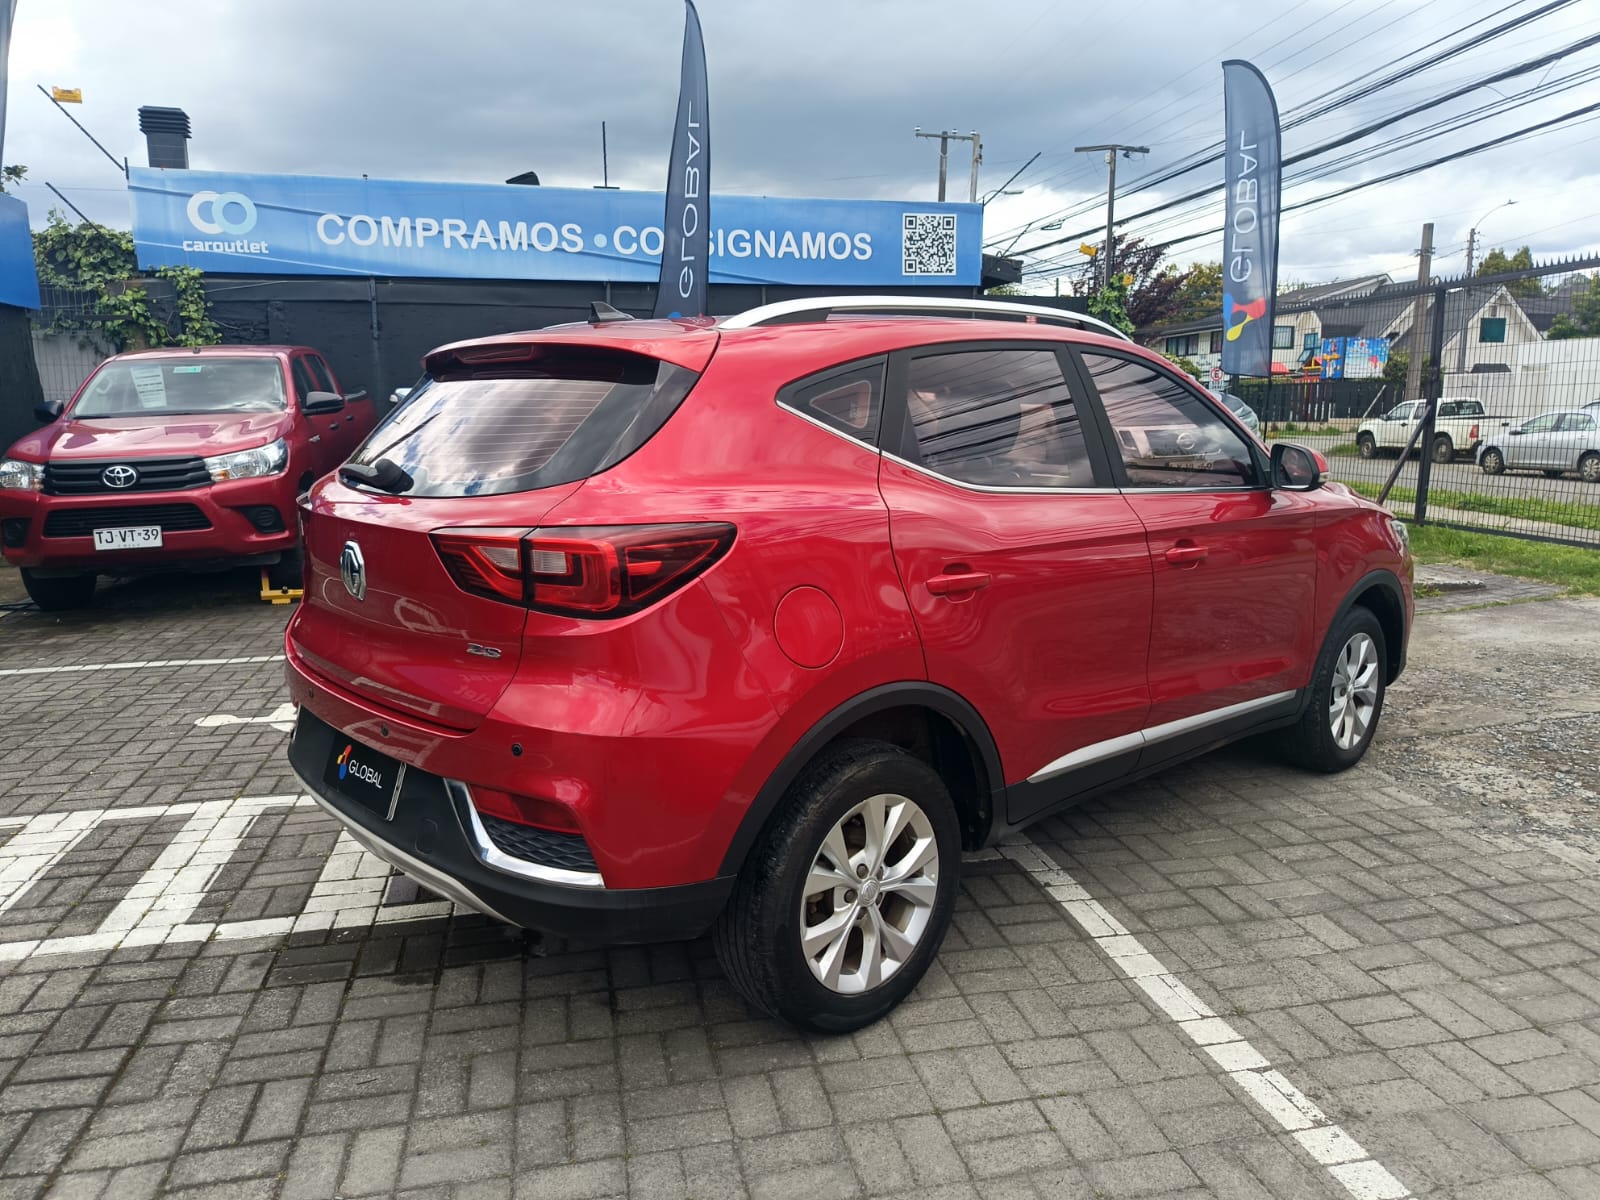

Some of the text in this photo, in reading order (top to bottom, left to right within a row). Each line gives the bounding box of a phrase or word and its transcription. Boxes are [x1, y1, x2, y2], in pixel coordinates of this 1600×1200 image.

[182, 240, 270, 254] caroutlet
[316, 213, 873, 261] COMPRAMOS COIGNAMOS
[348, 759, 383, 789] GLOBAL
